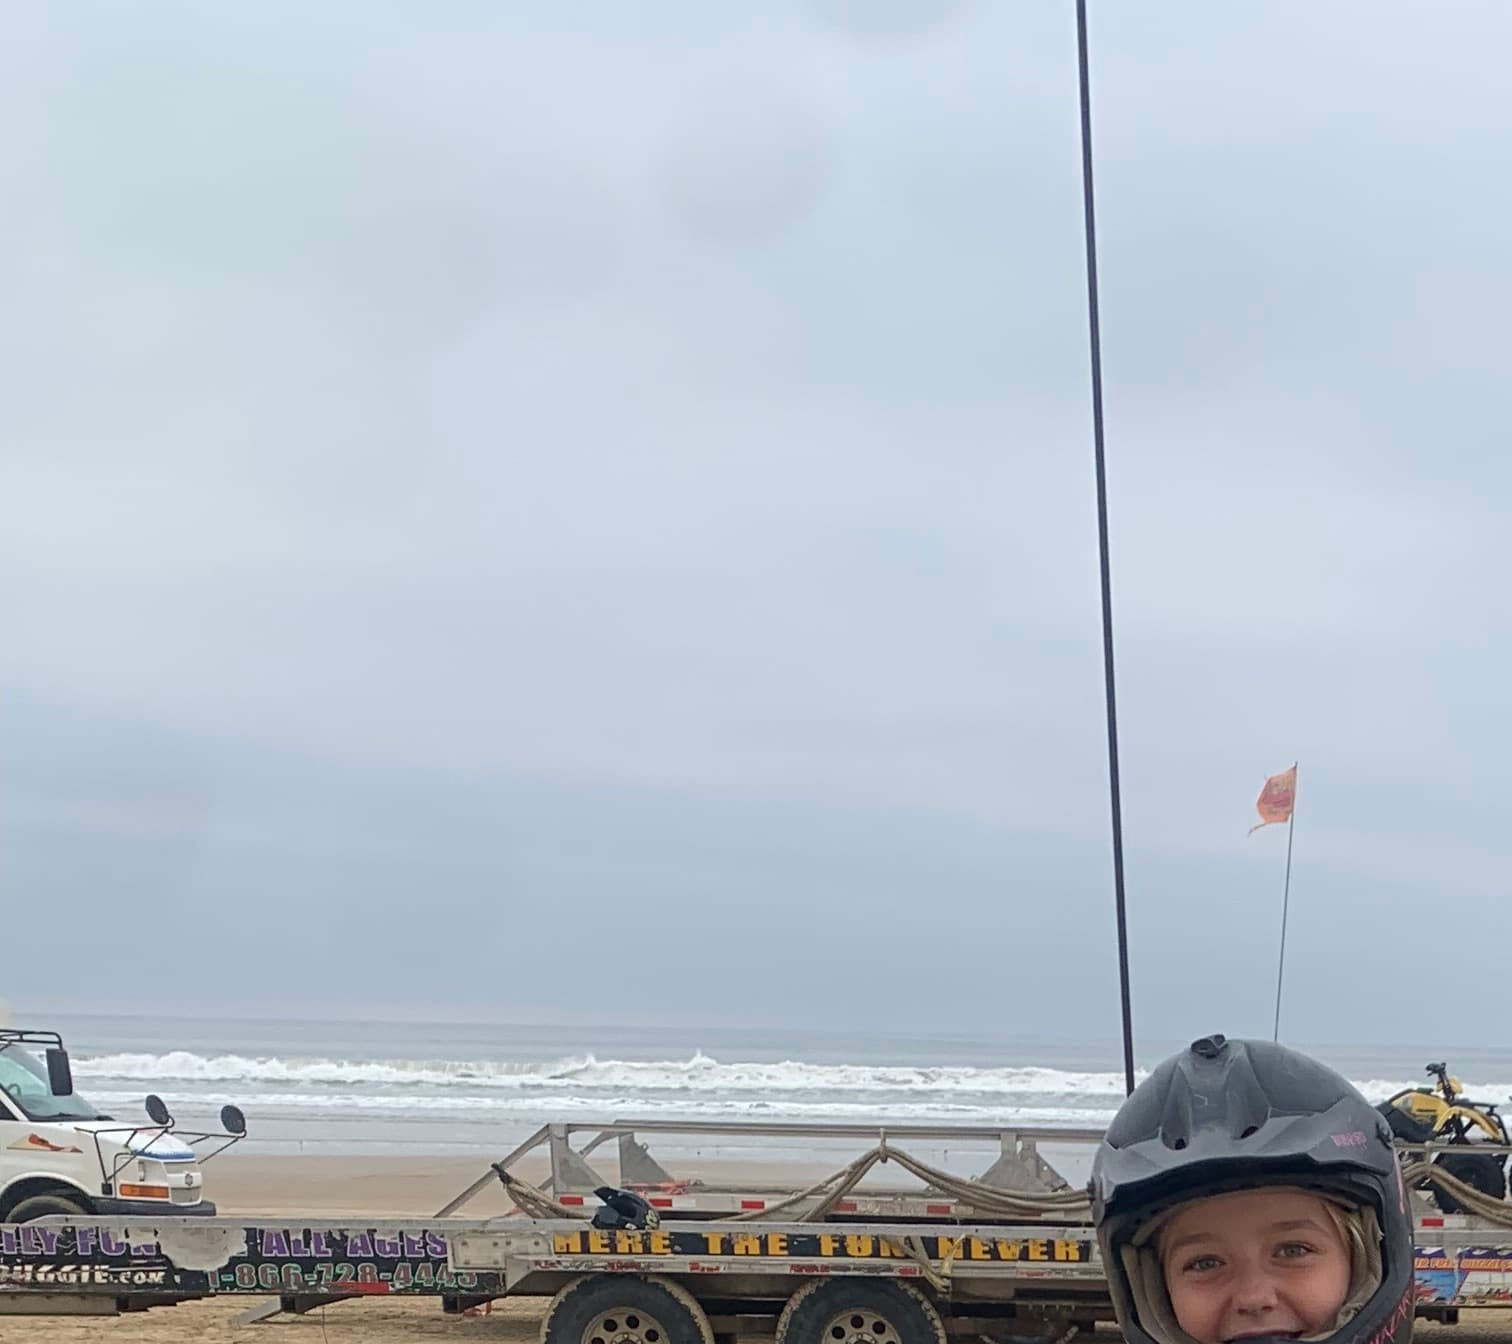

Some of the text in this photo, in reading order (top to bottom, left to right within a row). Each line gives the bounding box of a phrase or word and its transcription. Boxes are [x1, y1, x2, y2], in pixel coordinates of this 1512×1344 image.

[702, 1232, 790, 1256] THE
[819, 1233, 908, 1257] FUN
[937, 1235, 1081, 1262] NEVER
